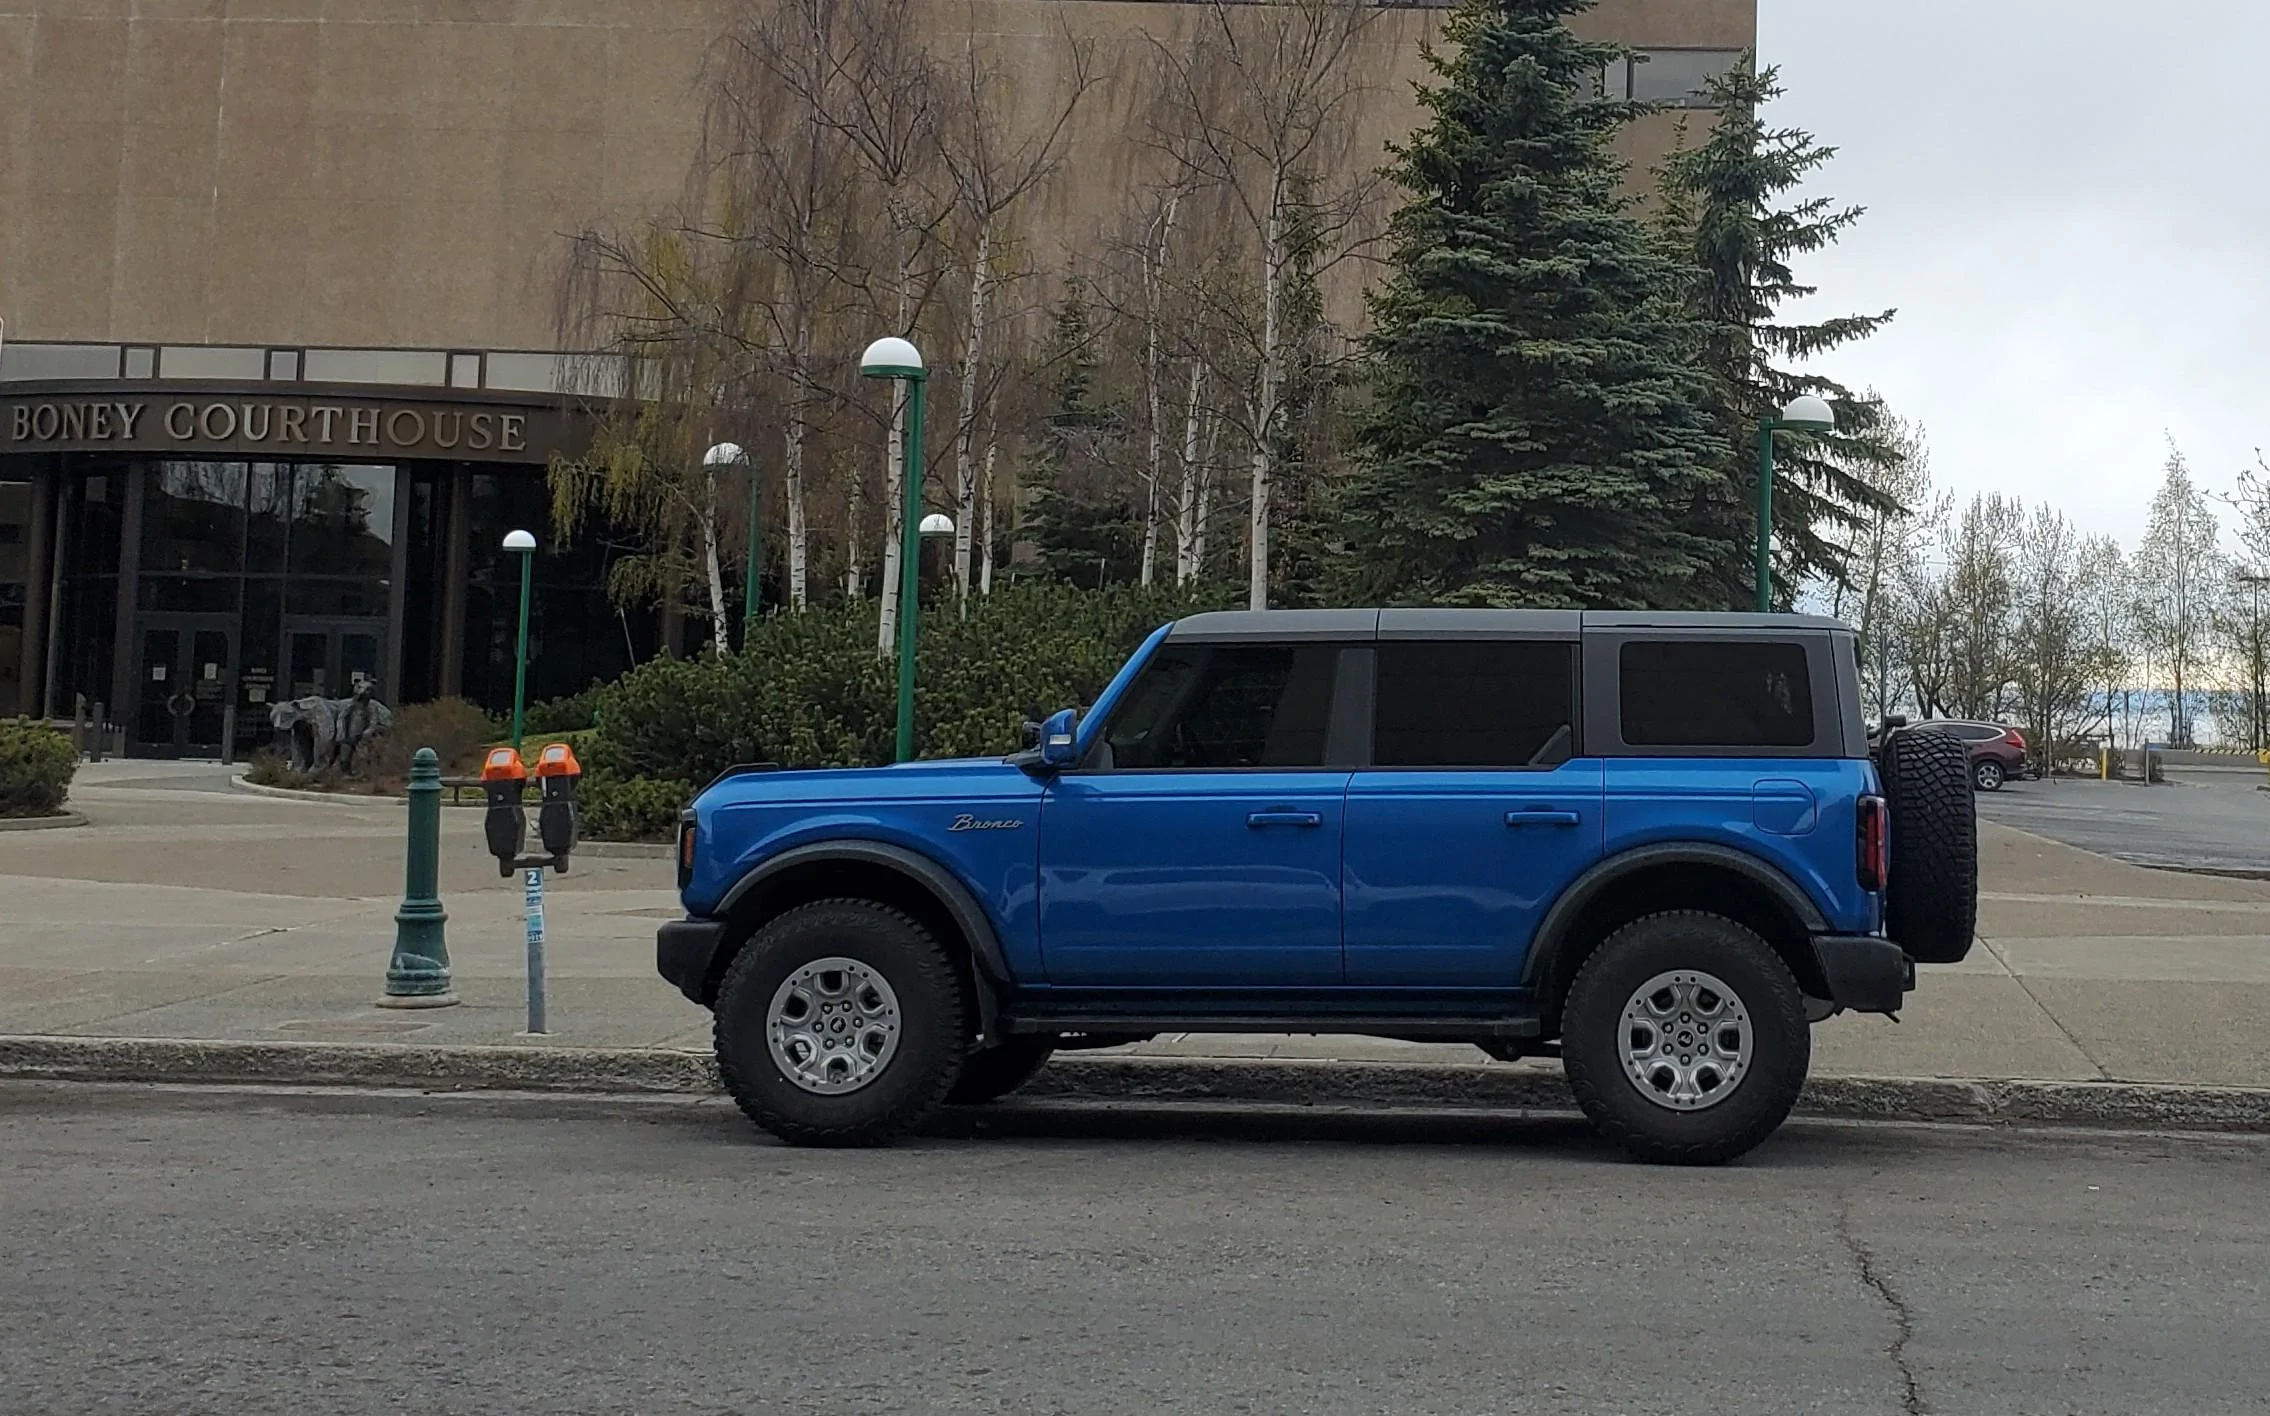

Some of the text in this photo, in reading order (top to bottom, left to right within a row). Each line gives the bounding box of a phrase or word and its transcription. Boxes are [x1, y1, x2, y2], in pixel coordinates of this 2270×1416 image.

[11, 402, 527, 451] BONEY COURTHOUSE
[946, 813, 1024, 831] Bronco
[527, 871, 538, 885] 2
